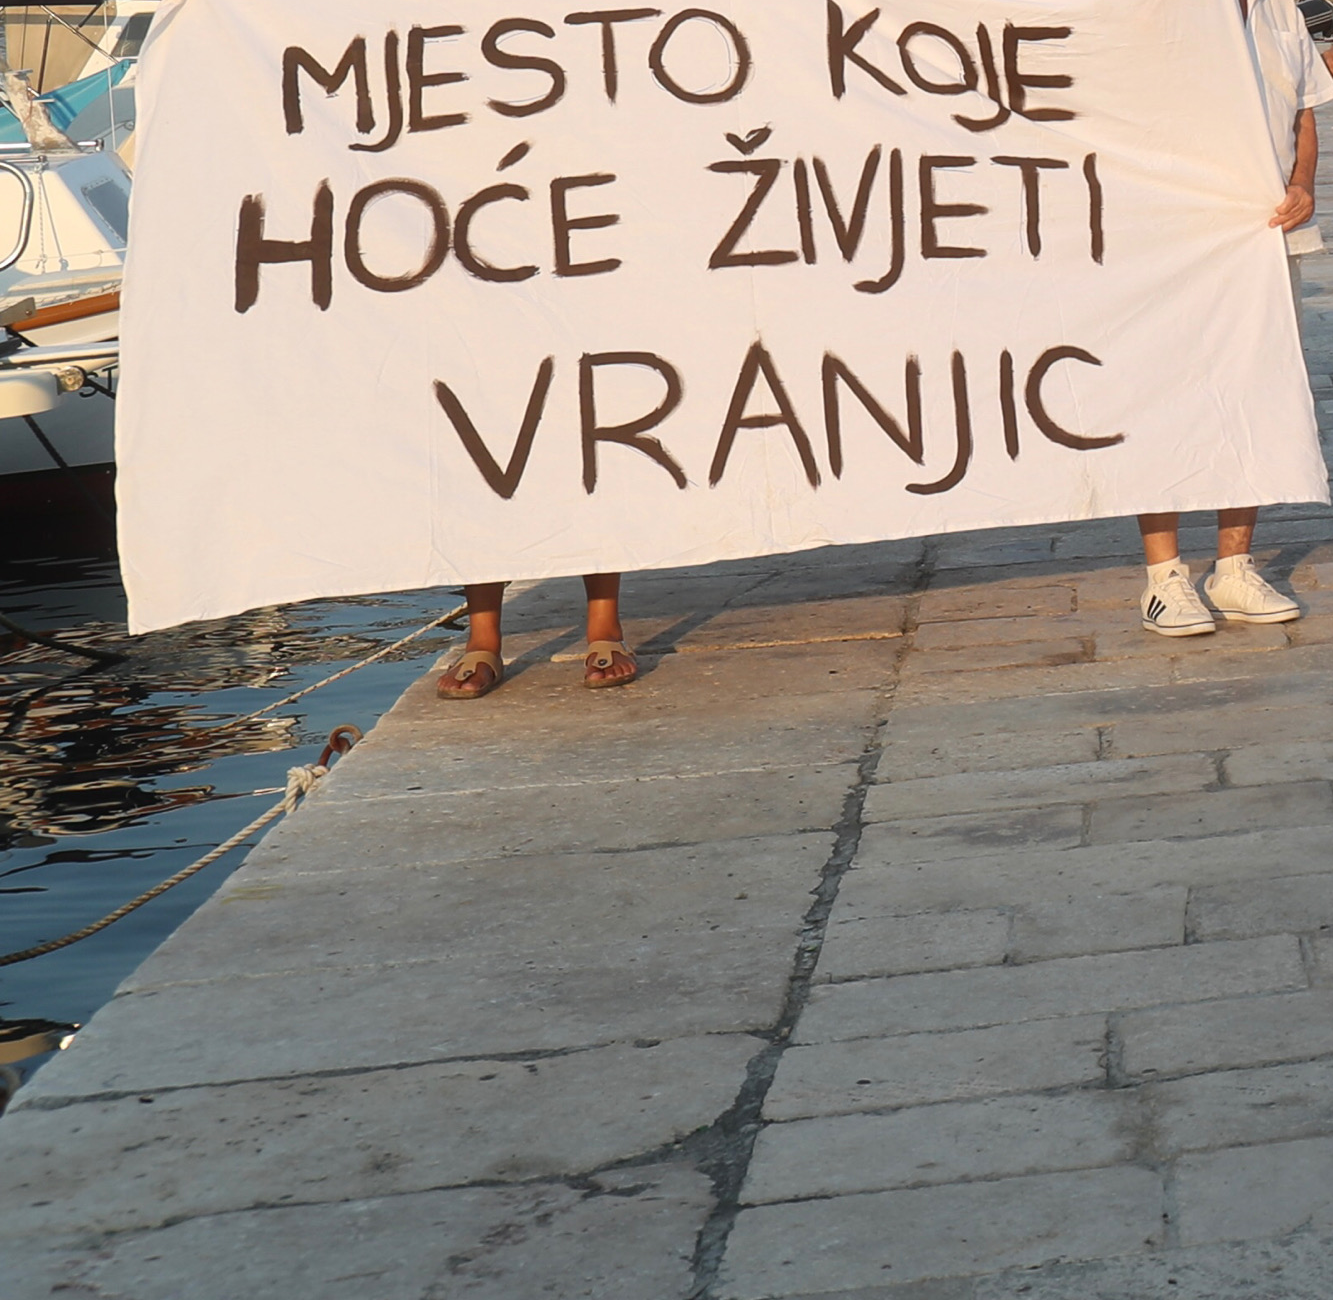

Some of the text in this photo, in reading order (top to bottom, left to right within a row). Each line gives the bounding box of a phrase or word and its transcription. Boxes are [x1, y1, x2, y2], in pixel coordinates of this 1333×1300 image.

[284, 6, 750, 151] MJESTO
[235, 125, 1104, 312] HOĆE ŽIVJETI
[434, 340, 1125, 499] VRANJIC
